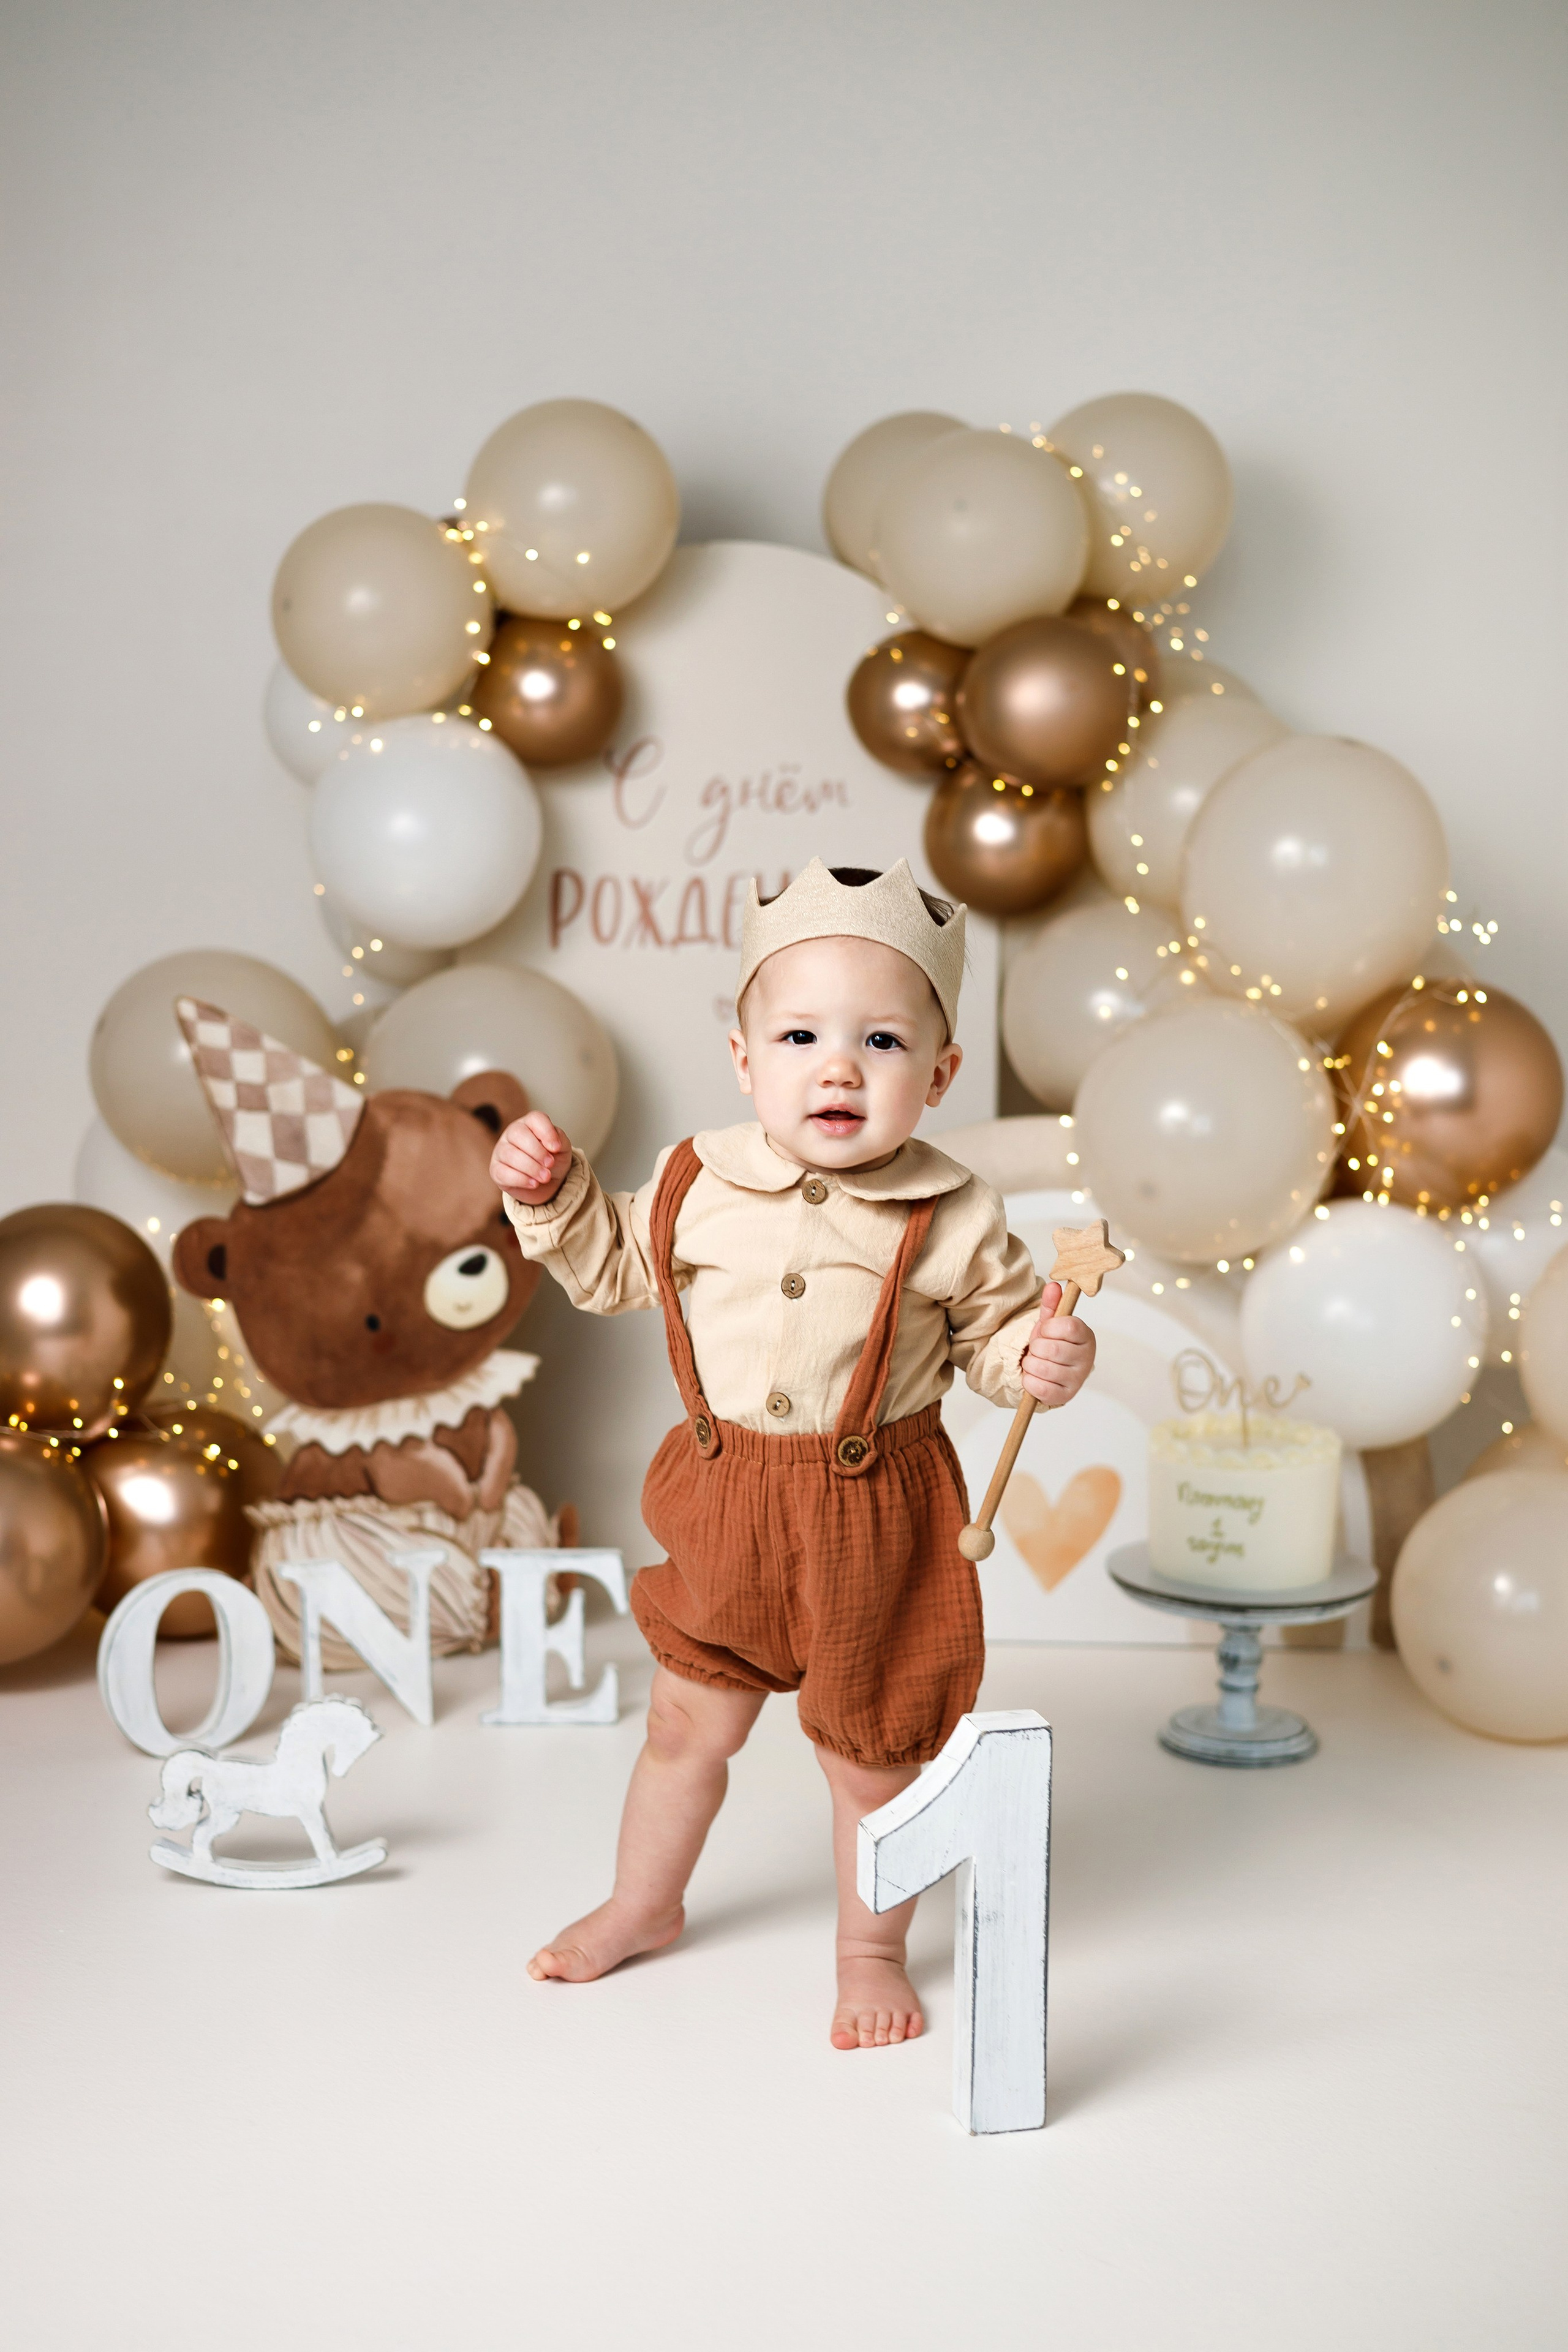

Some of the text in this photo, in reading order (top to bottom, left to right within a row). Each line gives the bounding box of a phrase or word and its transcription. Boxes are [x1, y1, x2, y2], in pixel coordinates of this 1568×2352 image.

[601, 737, 851, 868] С днём
[547, 866, 795, 951] РОЖДЕ
[1171, 1347, 1312, 1414] One
[97, 1548, 630, 1759] ONE
[857, 1709, 1054, 2136] 1
